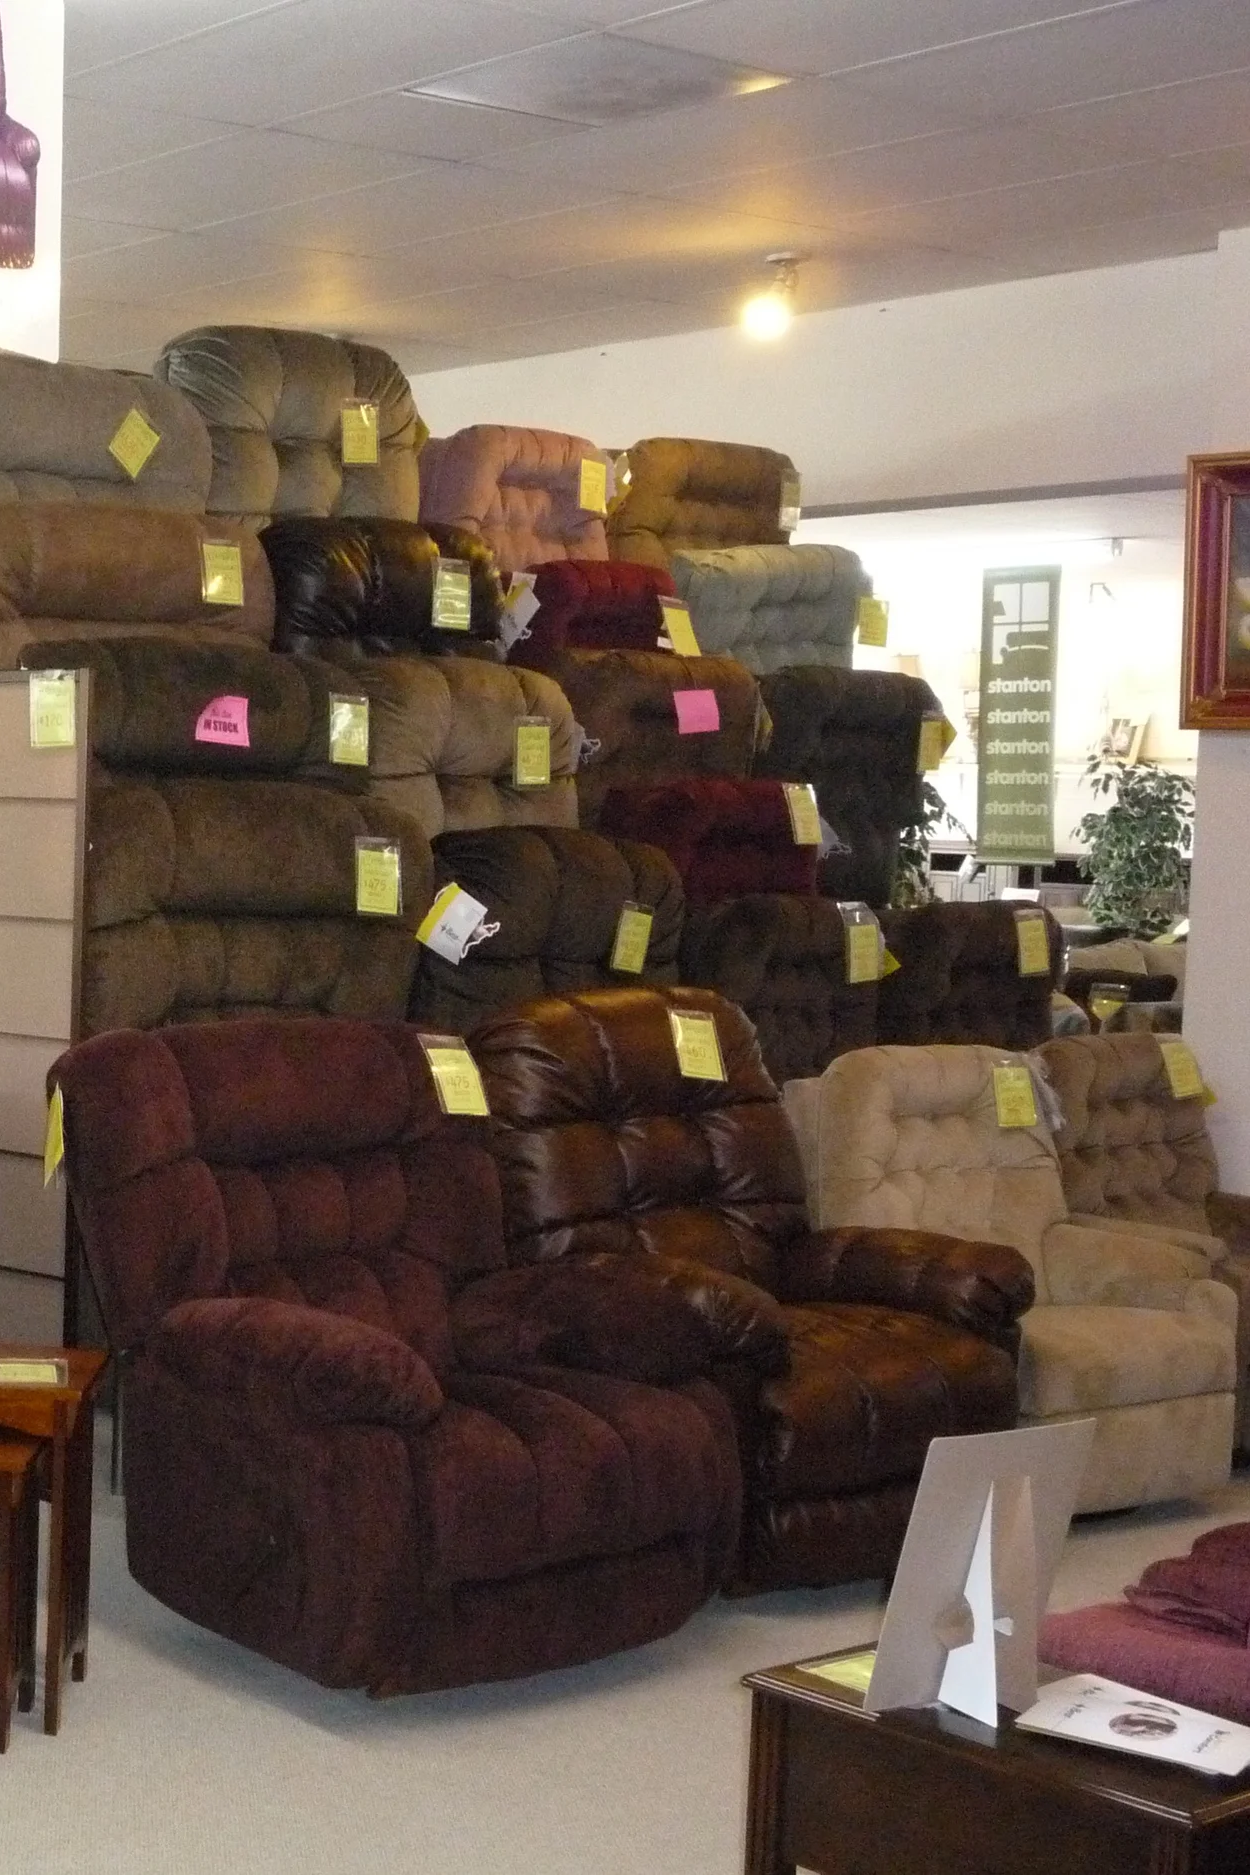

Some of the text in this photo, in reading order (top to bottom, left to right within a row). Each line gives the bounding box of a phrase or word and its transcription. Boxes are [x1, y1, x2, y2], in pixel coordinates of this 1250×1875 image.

[988, 677, 1051, 694] stanton
[987, 708, 1051, 724] stanton
[203, 719, 239, 733] IN STOCK
[986, 739, 1050, 755] stanton
[985, 769, 1049, 785] stanton
[984, 800, 1048, 816] stanton
[983, 831, 1047, 847] stanton
